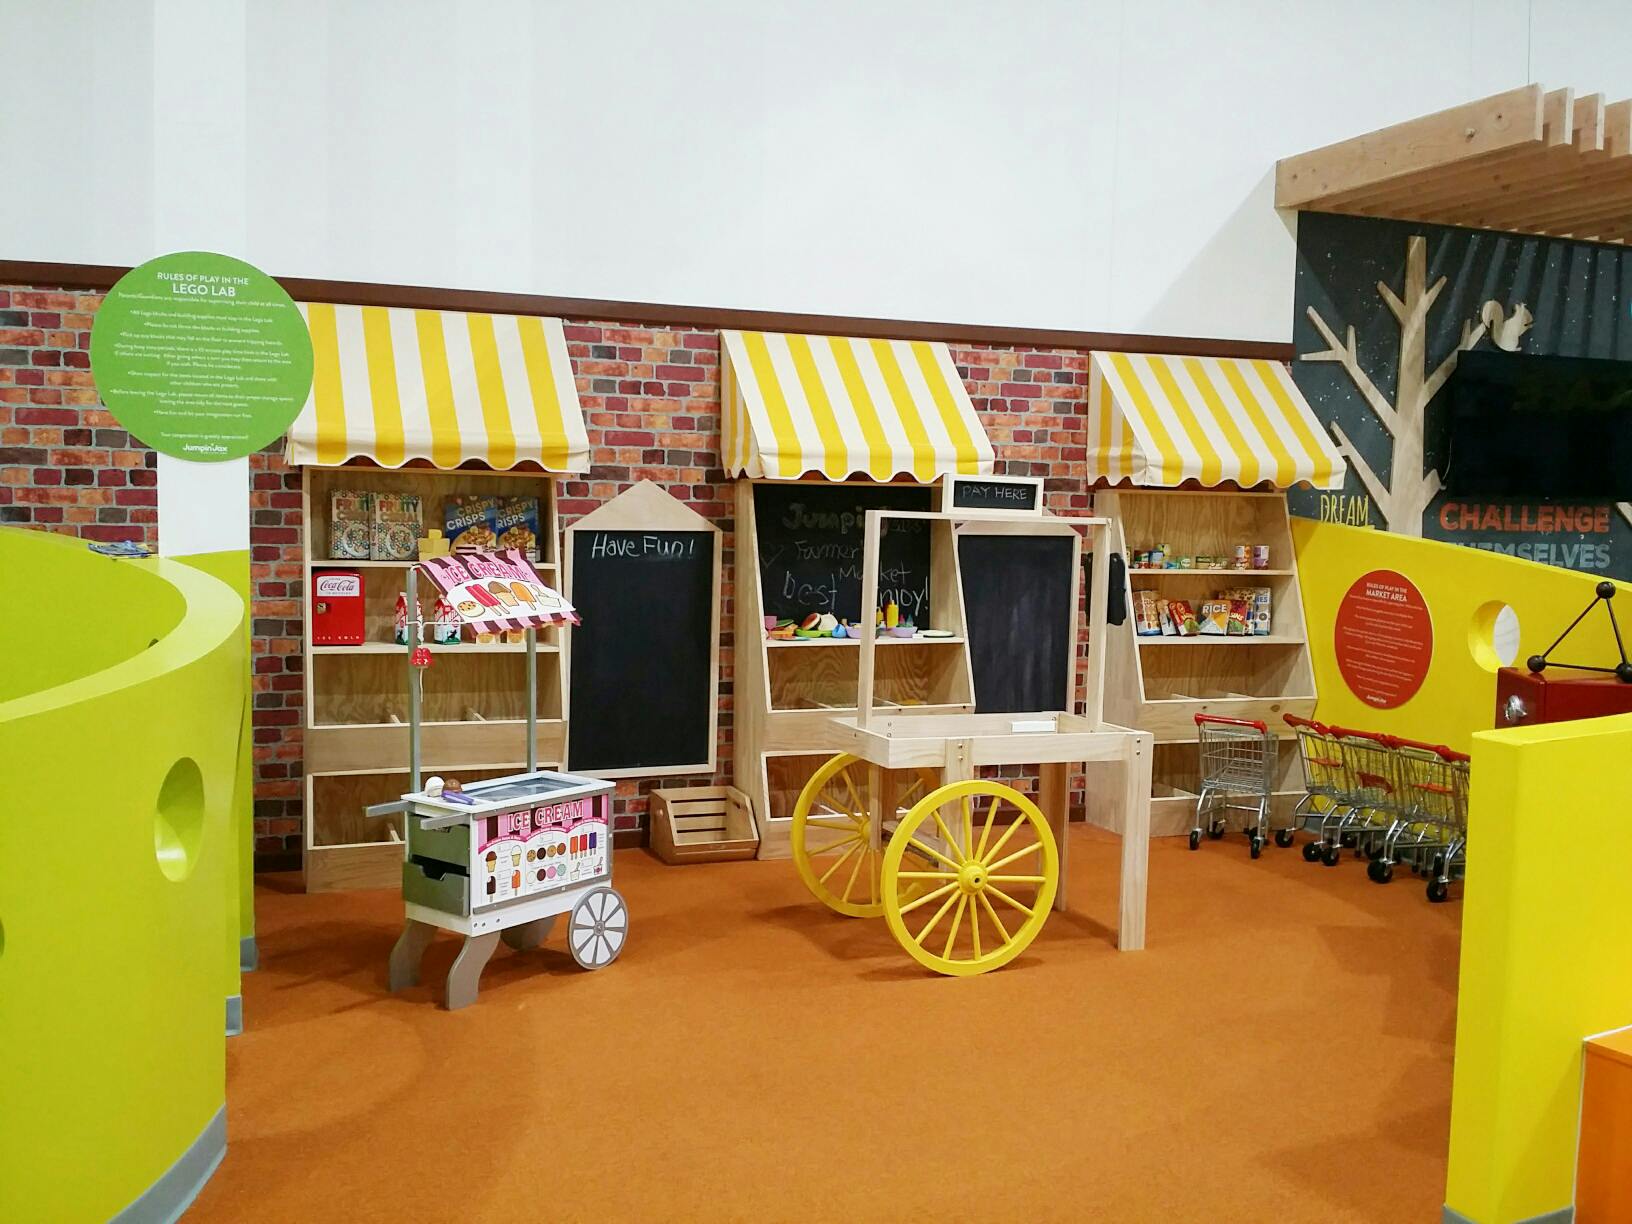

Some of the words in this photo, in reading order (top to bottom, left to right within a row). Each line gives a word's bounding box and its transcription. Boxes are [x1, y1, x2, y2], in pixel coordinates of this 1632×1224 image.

[157, 272, 184, 281] RULES
[186, 274, 198, 282] OF
[199, 275, 220, 283] PLAY
[232, 277, 249, 285] THE
[172, 283, 208, 295] LEGO
[211, 286, 236, 297] LAB
[962, 485, 991, 499] PAY
[995, 487, 1027, 500] HERE
[1320, 494, 1369, 527] DREAM
[1439, 502, 1610, 533] CHALLENGE
[446, 512, 486, 530] CRISPS
[496, 512, 526, 529] RISPS
[591, 532, 640, 559] Have
[445, 565, 471, 584] ICE
[467, 561, 527, 580] CREAM
[1366, 589, 1390, 599] MARKET
[1390, 593, 1408, 602] AREA
[1202, 604, 1228, 614] RICE
[508, 811, 532, 833] ICE
[534, 800, 584, 827] CREAM
